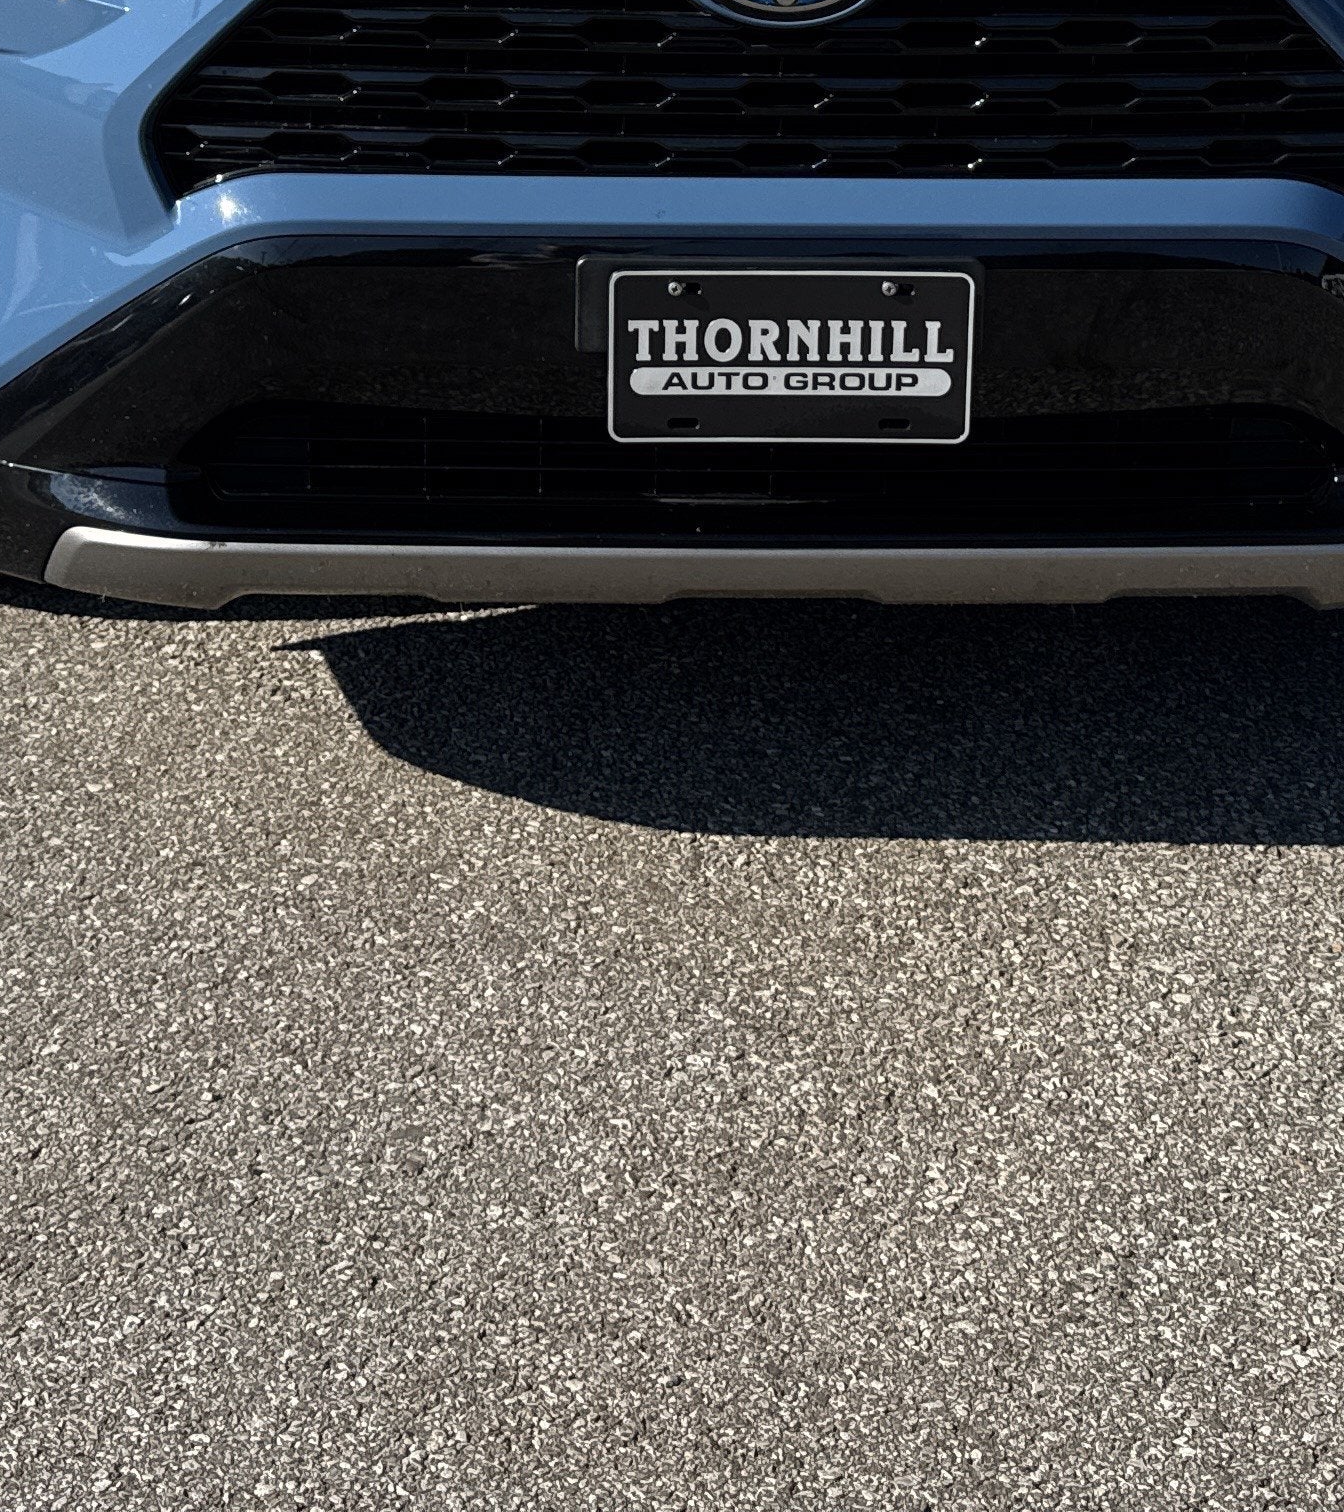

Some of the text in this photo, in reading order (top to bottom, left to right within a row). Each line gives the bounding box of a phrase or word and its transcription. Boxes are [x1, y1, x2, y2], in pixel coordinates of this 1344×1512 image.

[627, 318, 954, 363] THORNHILL
[661, 371, 920, 392] AUTO GROUP
